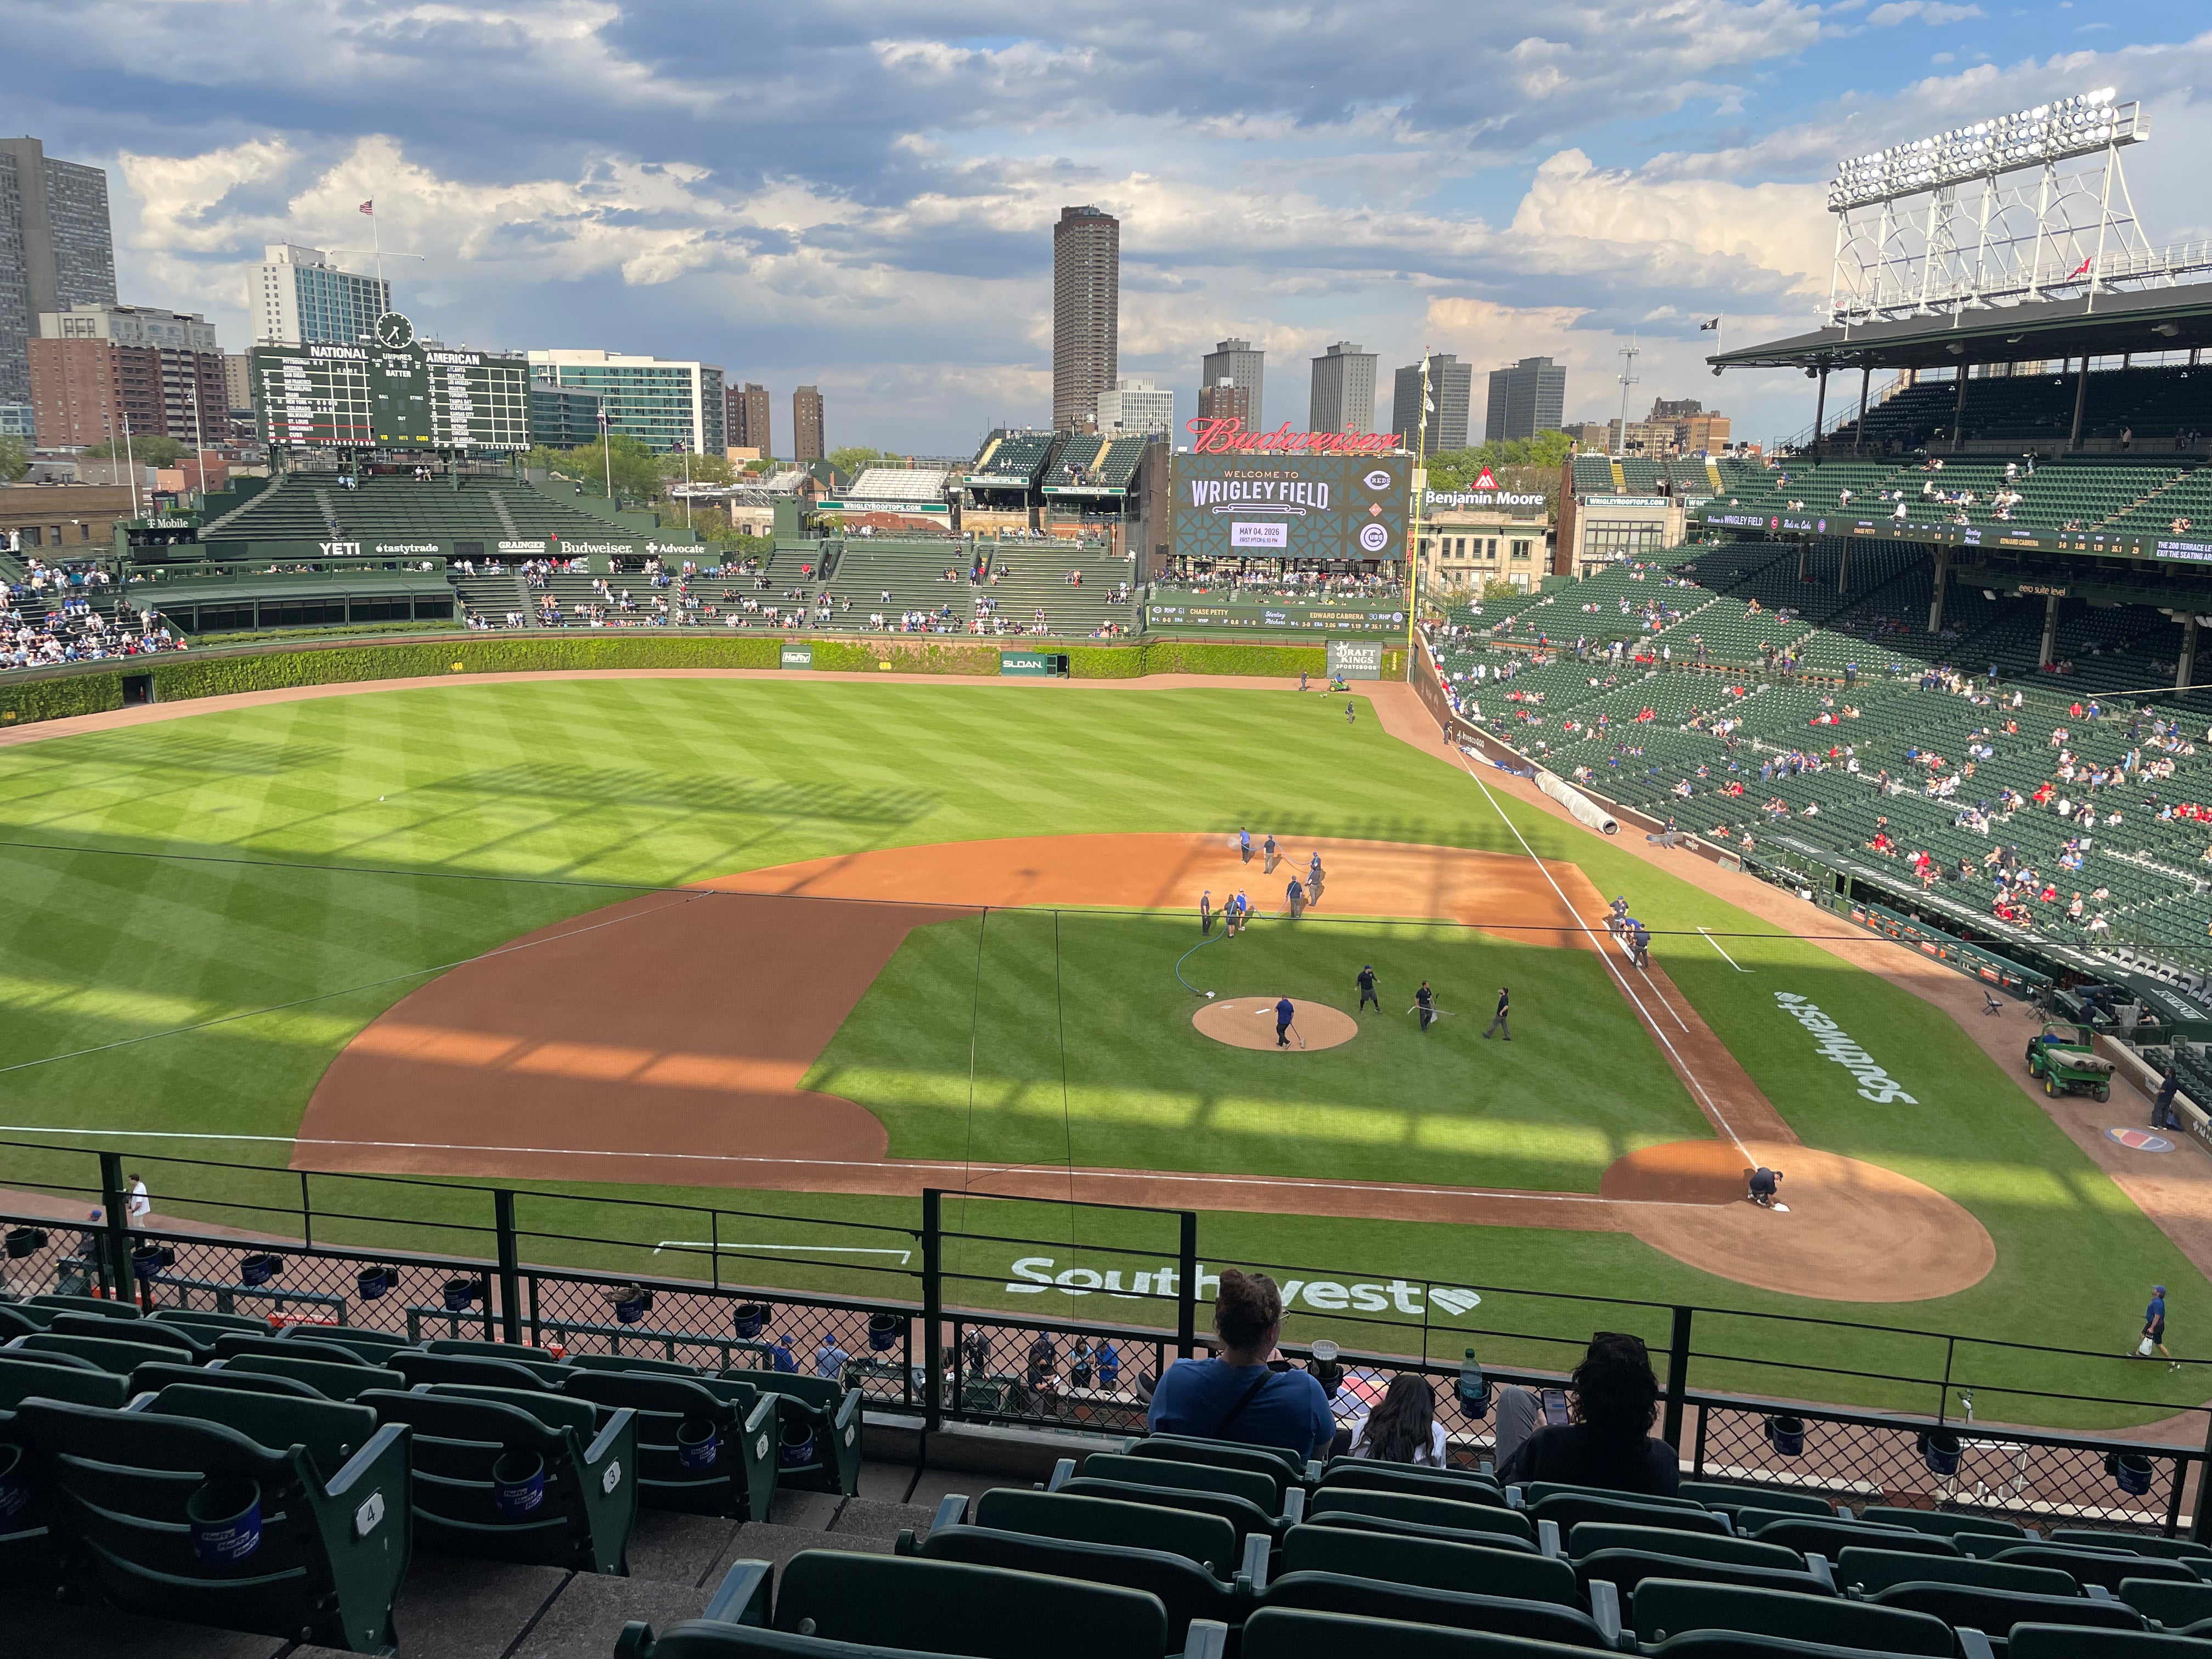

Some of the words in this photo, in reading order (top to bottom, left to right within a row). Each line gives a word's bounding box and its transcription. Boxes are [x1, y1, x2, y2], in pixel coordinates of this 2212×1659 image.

[311, 346, 369, 359] NATIONAL
[426, 352, 479, 365] AMERICAN
[1186, 417, 1402, 453] Budweiser
[1224, 470, 1279, 478] WELCOME
[1192, 481, 1275, 507] WRIGLEY
[1279, 482, 1329, 509] FIELD
[1426, 491, 1492, 507] Benjamin
[1497, 492, 1543, 505] Moore
[157, 518, 188, 528] Mobile
[1724, 515, 1747, 525] WRIGLEY
[1748, 517, 1763, 526] FIELD
[1784, 519, 1793, 528] Reds
[1801, 520, 1811, 529] Cubs
[1254, 528, 1263, 536] 04,
[319, 543, 360, 555] YETI
[383, 543, 438, 554] tastytrade
[561, 542, 632, 553] Budweiser
[659, 544, 704, 554] Advocate
[2074, 542, 2086, 550] 3.06
[2180, 543, 2204, 551] TERRACE
[2180, 551, 2203, 560] SEATING
[2035, 585, 2049, 594] suite
[2051, 586, 2066, 596] level
[1265, 611, 1285, 619] Starting
[784, 653, 809, 662] Hefty
[1336, 648, 1375, 657] DRAFT
[1341, 656, 1374, 664] KINGS
[1778, 1002, 1919, 1104] Southwest
[848, 1431, 851, 1440] 1
[760, 1441, 764, 1453] 2
[609, 1470, 616, 1484] 3
[367, 1504, 375, 1521] 4
